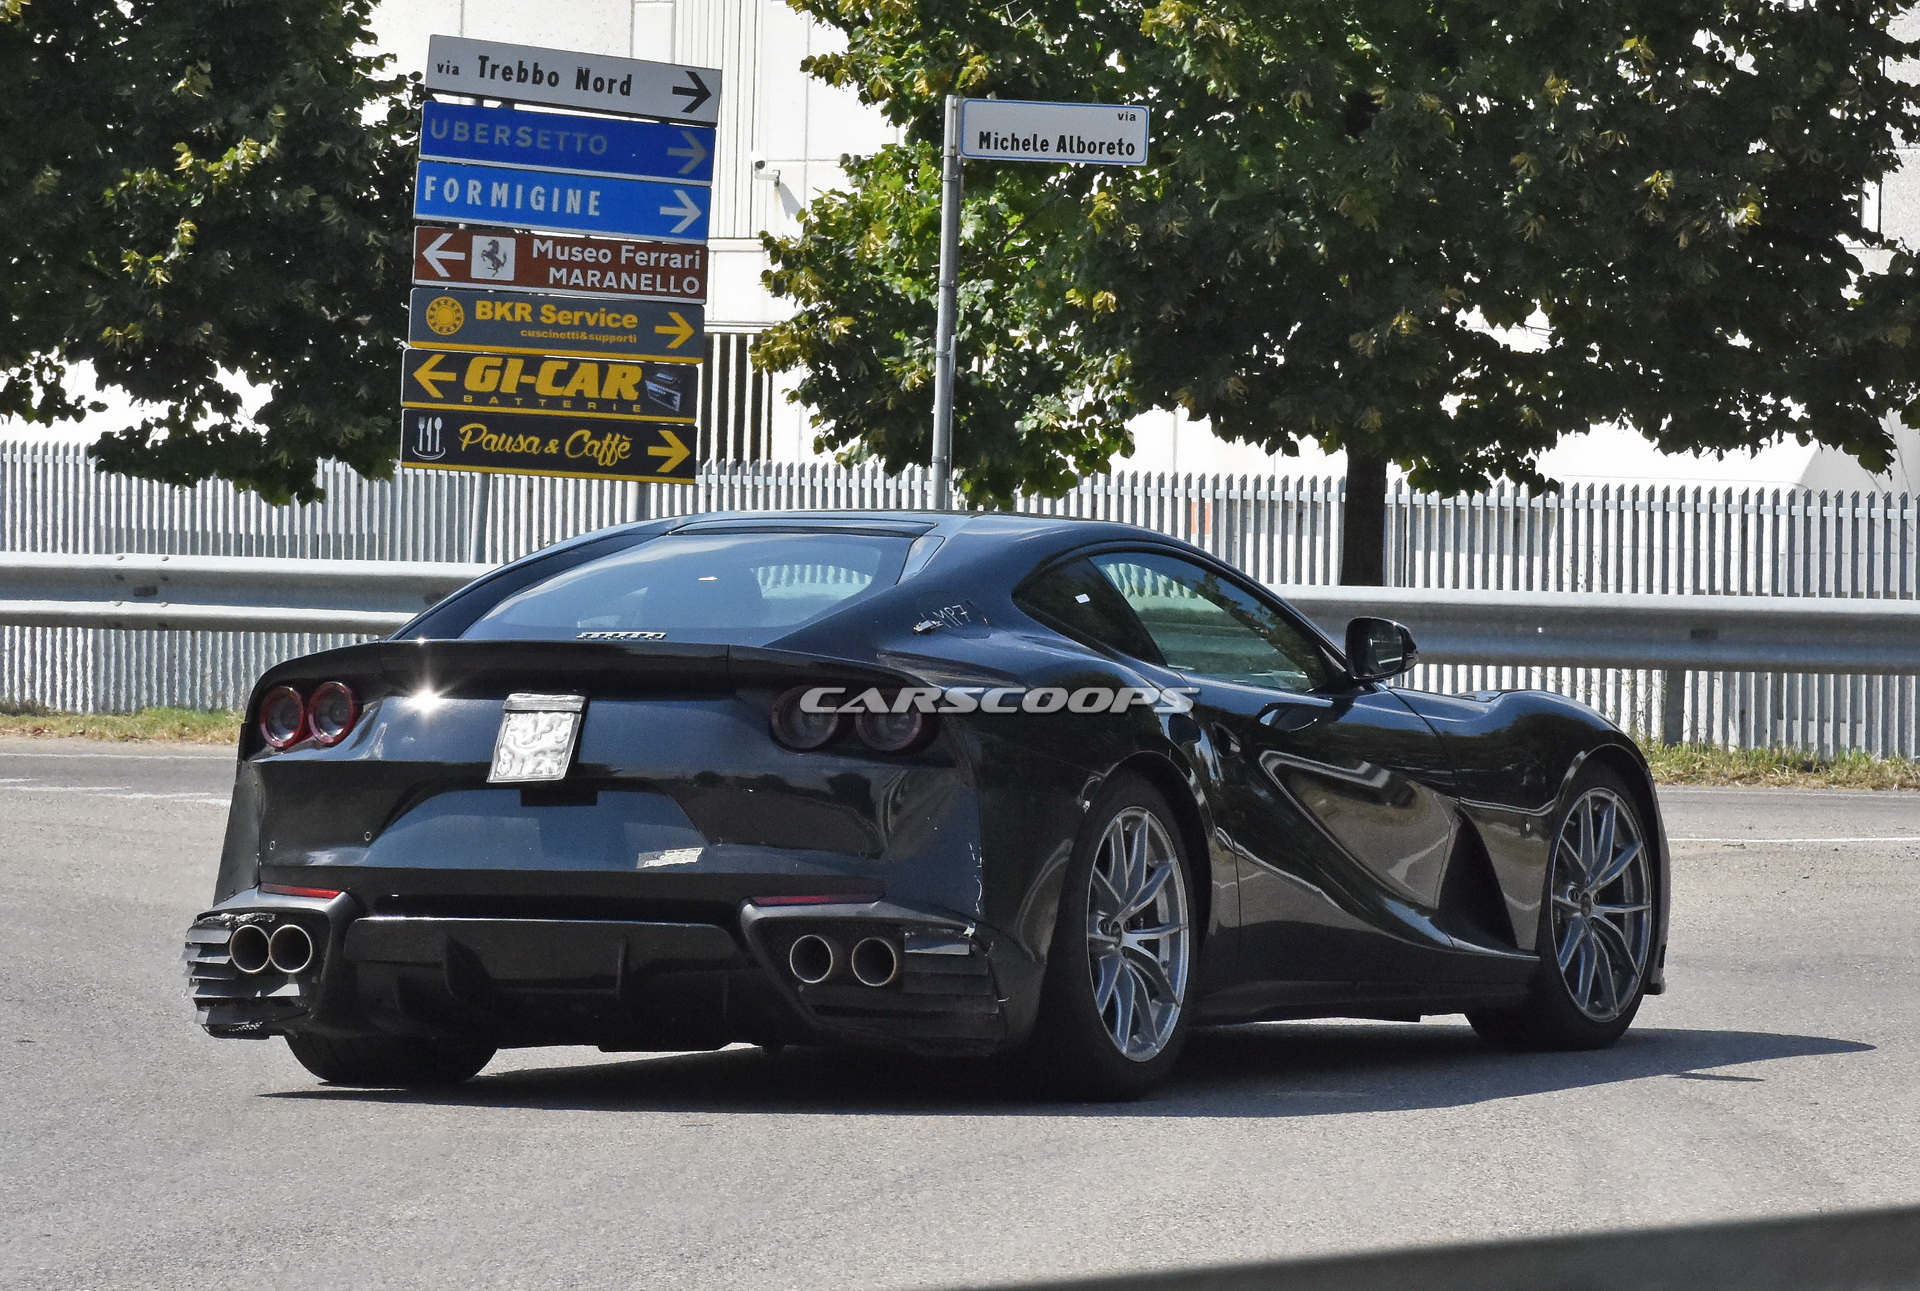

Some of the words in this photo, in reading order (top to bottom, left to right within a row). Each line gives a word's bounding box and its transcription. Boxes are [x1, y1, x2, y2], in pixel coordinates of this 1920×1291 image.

[437, 60, 459, 75] via
[478, 55, 560, 88] Trebbo
[575, 66, 633, 97] Nord
[1117, 111, 1136, 122] via
[430, 118, 608, 155] UBERSETTO
[978, 131, 1049, 153] Michele
[1056, 134, 1135, 156] Alboreto
[425, 176, 601, 216] FORMIGINE
[532, 239, 612, 264] Museo
[620, 245, 701, 270] Ferrari
[549, 267, 701, 294] MARANELLO
[475, 300, 533, 322] BKR
[539, 303, 638, 329] Service
[520, 329, 637, 344] cuscinetti&supporti
[464, 356, 642, 401] GI-CAR
[463, 395, 641, 413] BATTERIE
[458, 423, 542, 454] Pausa
[544, 438, 559, 454] &
[565, 429, 633, 467] Caffè
